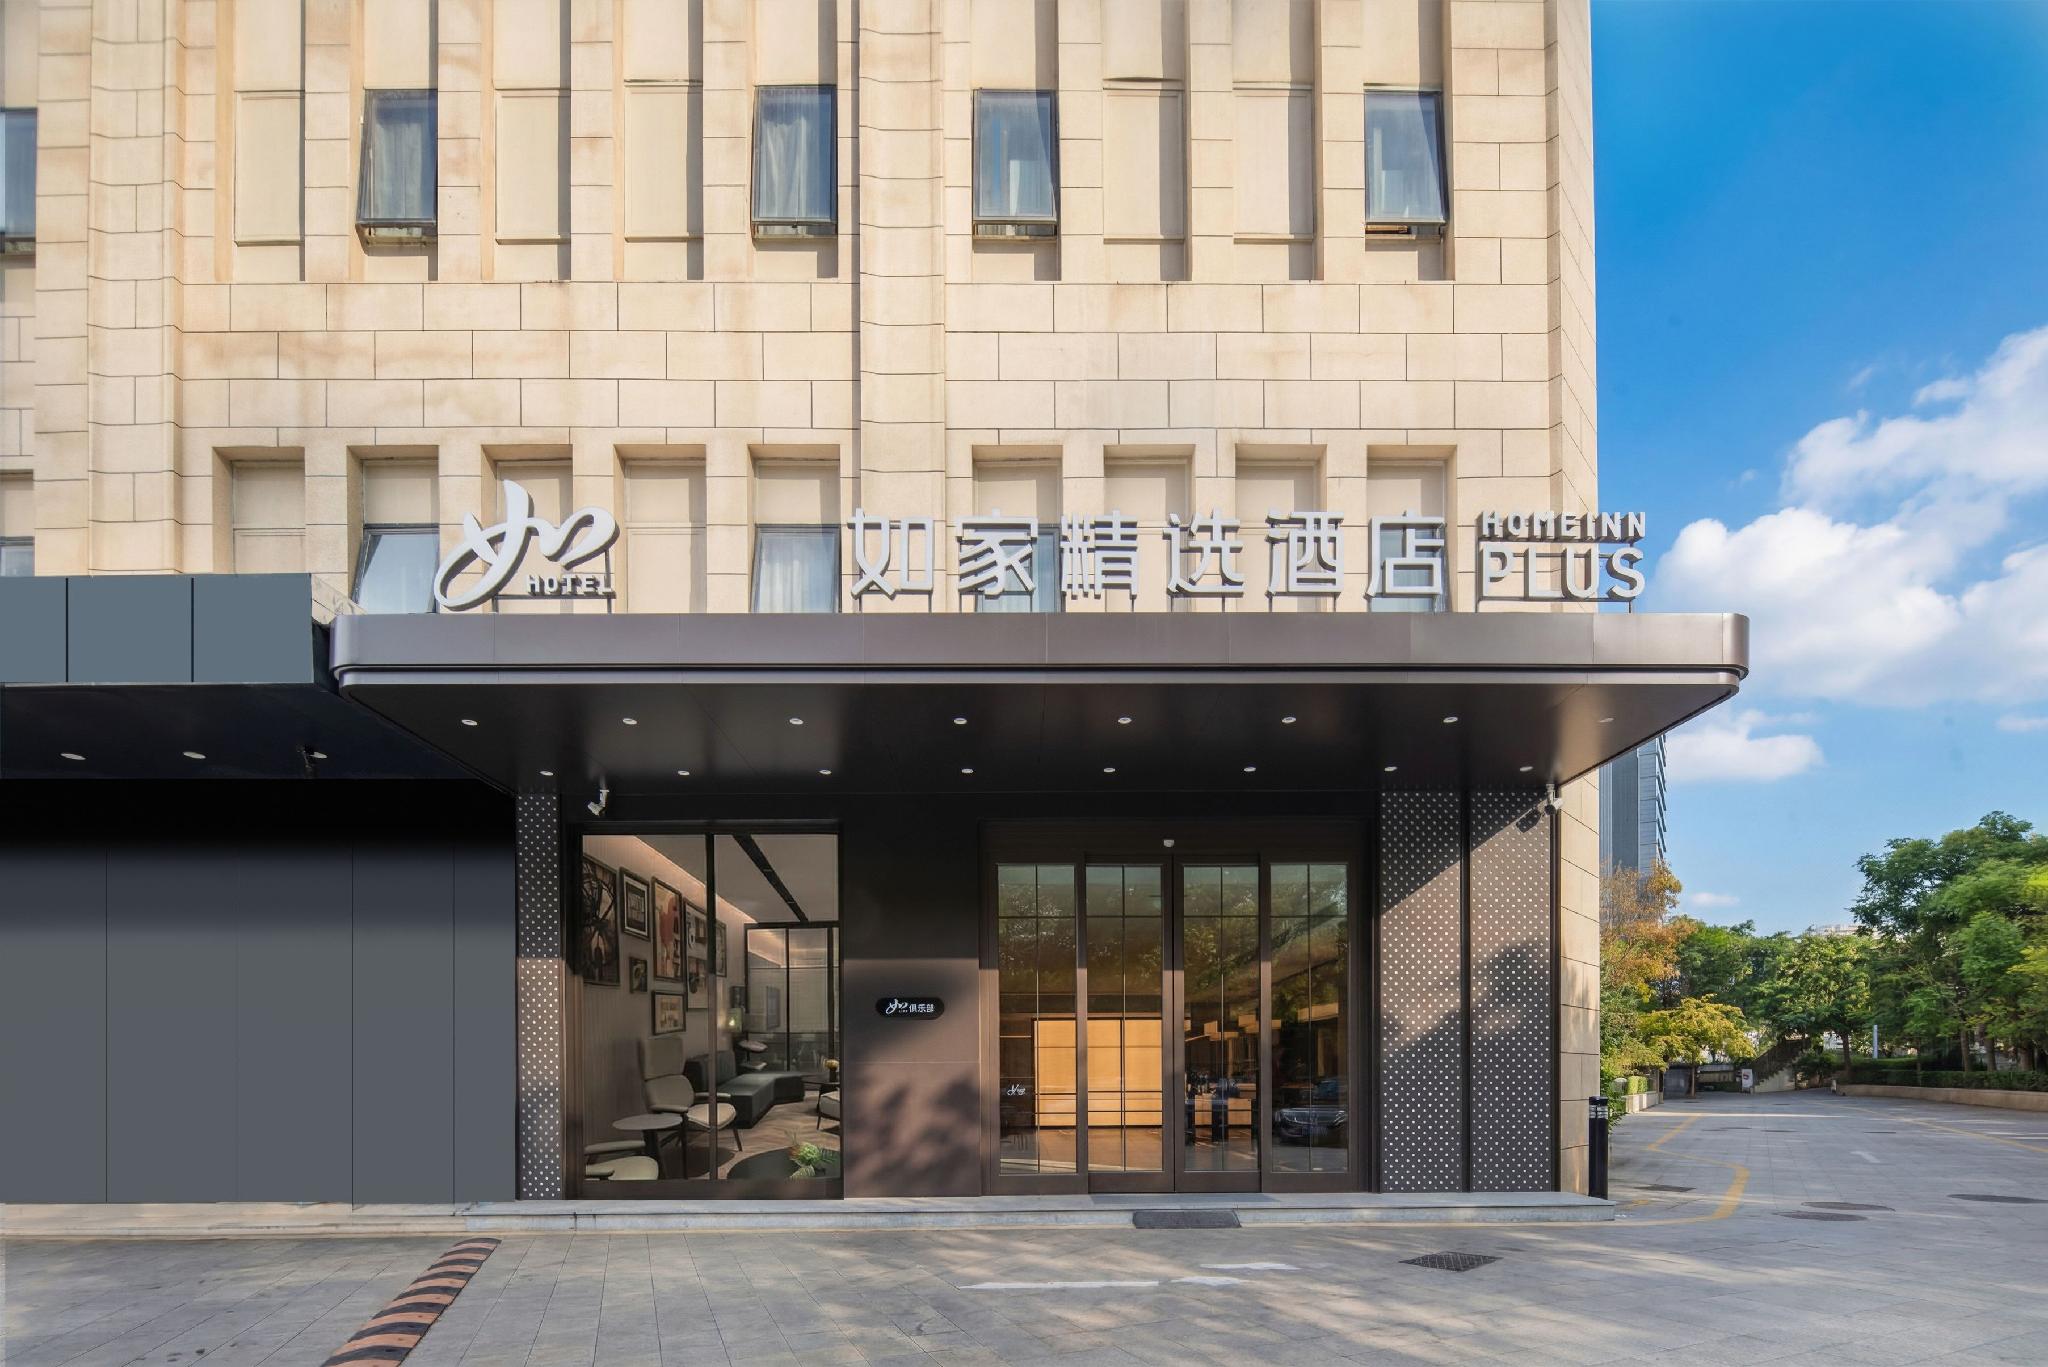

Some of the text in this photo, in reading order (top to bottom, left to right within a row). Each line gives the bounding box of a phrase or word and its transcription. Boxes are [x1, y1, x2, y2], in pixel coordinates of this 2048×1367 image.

[847, 507, 1446, 600] 如家精选酒店
[1478, 546, 1646, 600] PLUS
[526, 574, 614, 596] HOTEL
